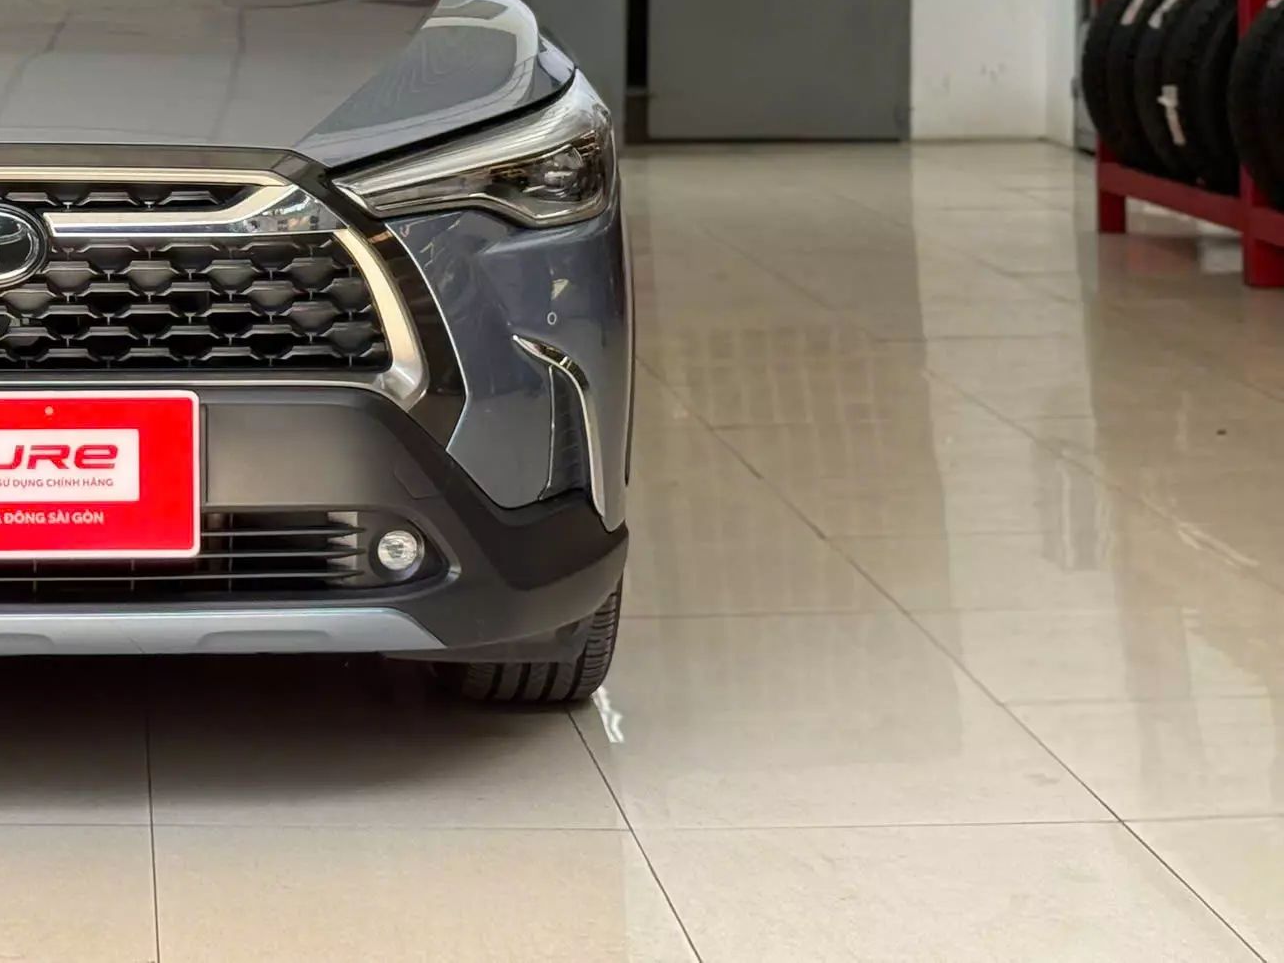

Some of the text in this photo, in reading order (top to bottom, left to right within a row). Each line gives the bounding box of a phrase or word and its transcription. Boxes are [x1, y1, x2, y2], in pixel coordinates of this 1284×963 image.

[46, 477, 80, 487] CHÍNH
[3, 509, 46, 524] ĐÔNG
[47, 509, 70, 524] SÀI
[71, 509, 104, 524] GÒN
